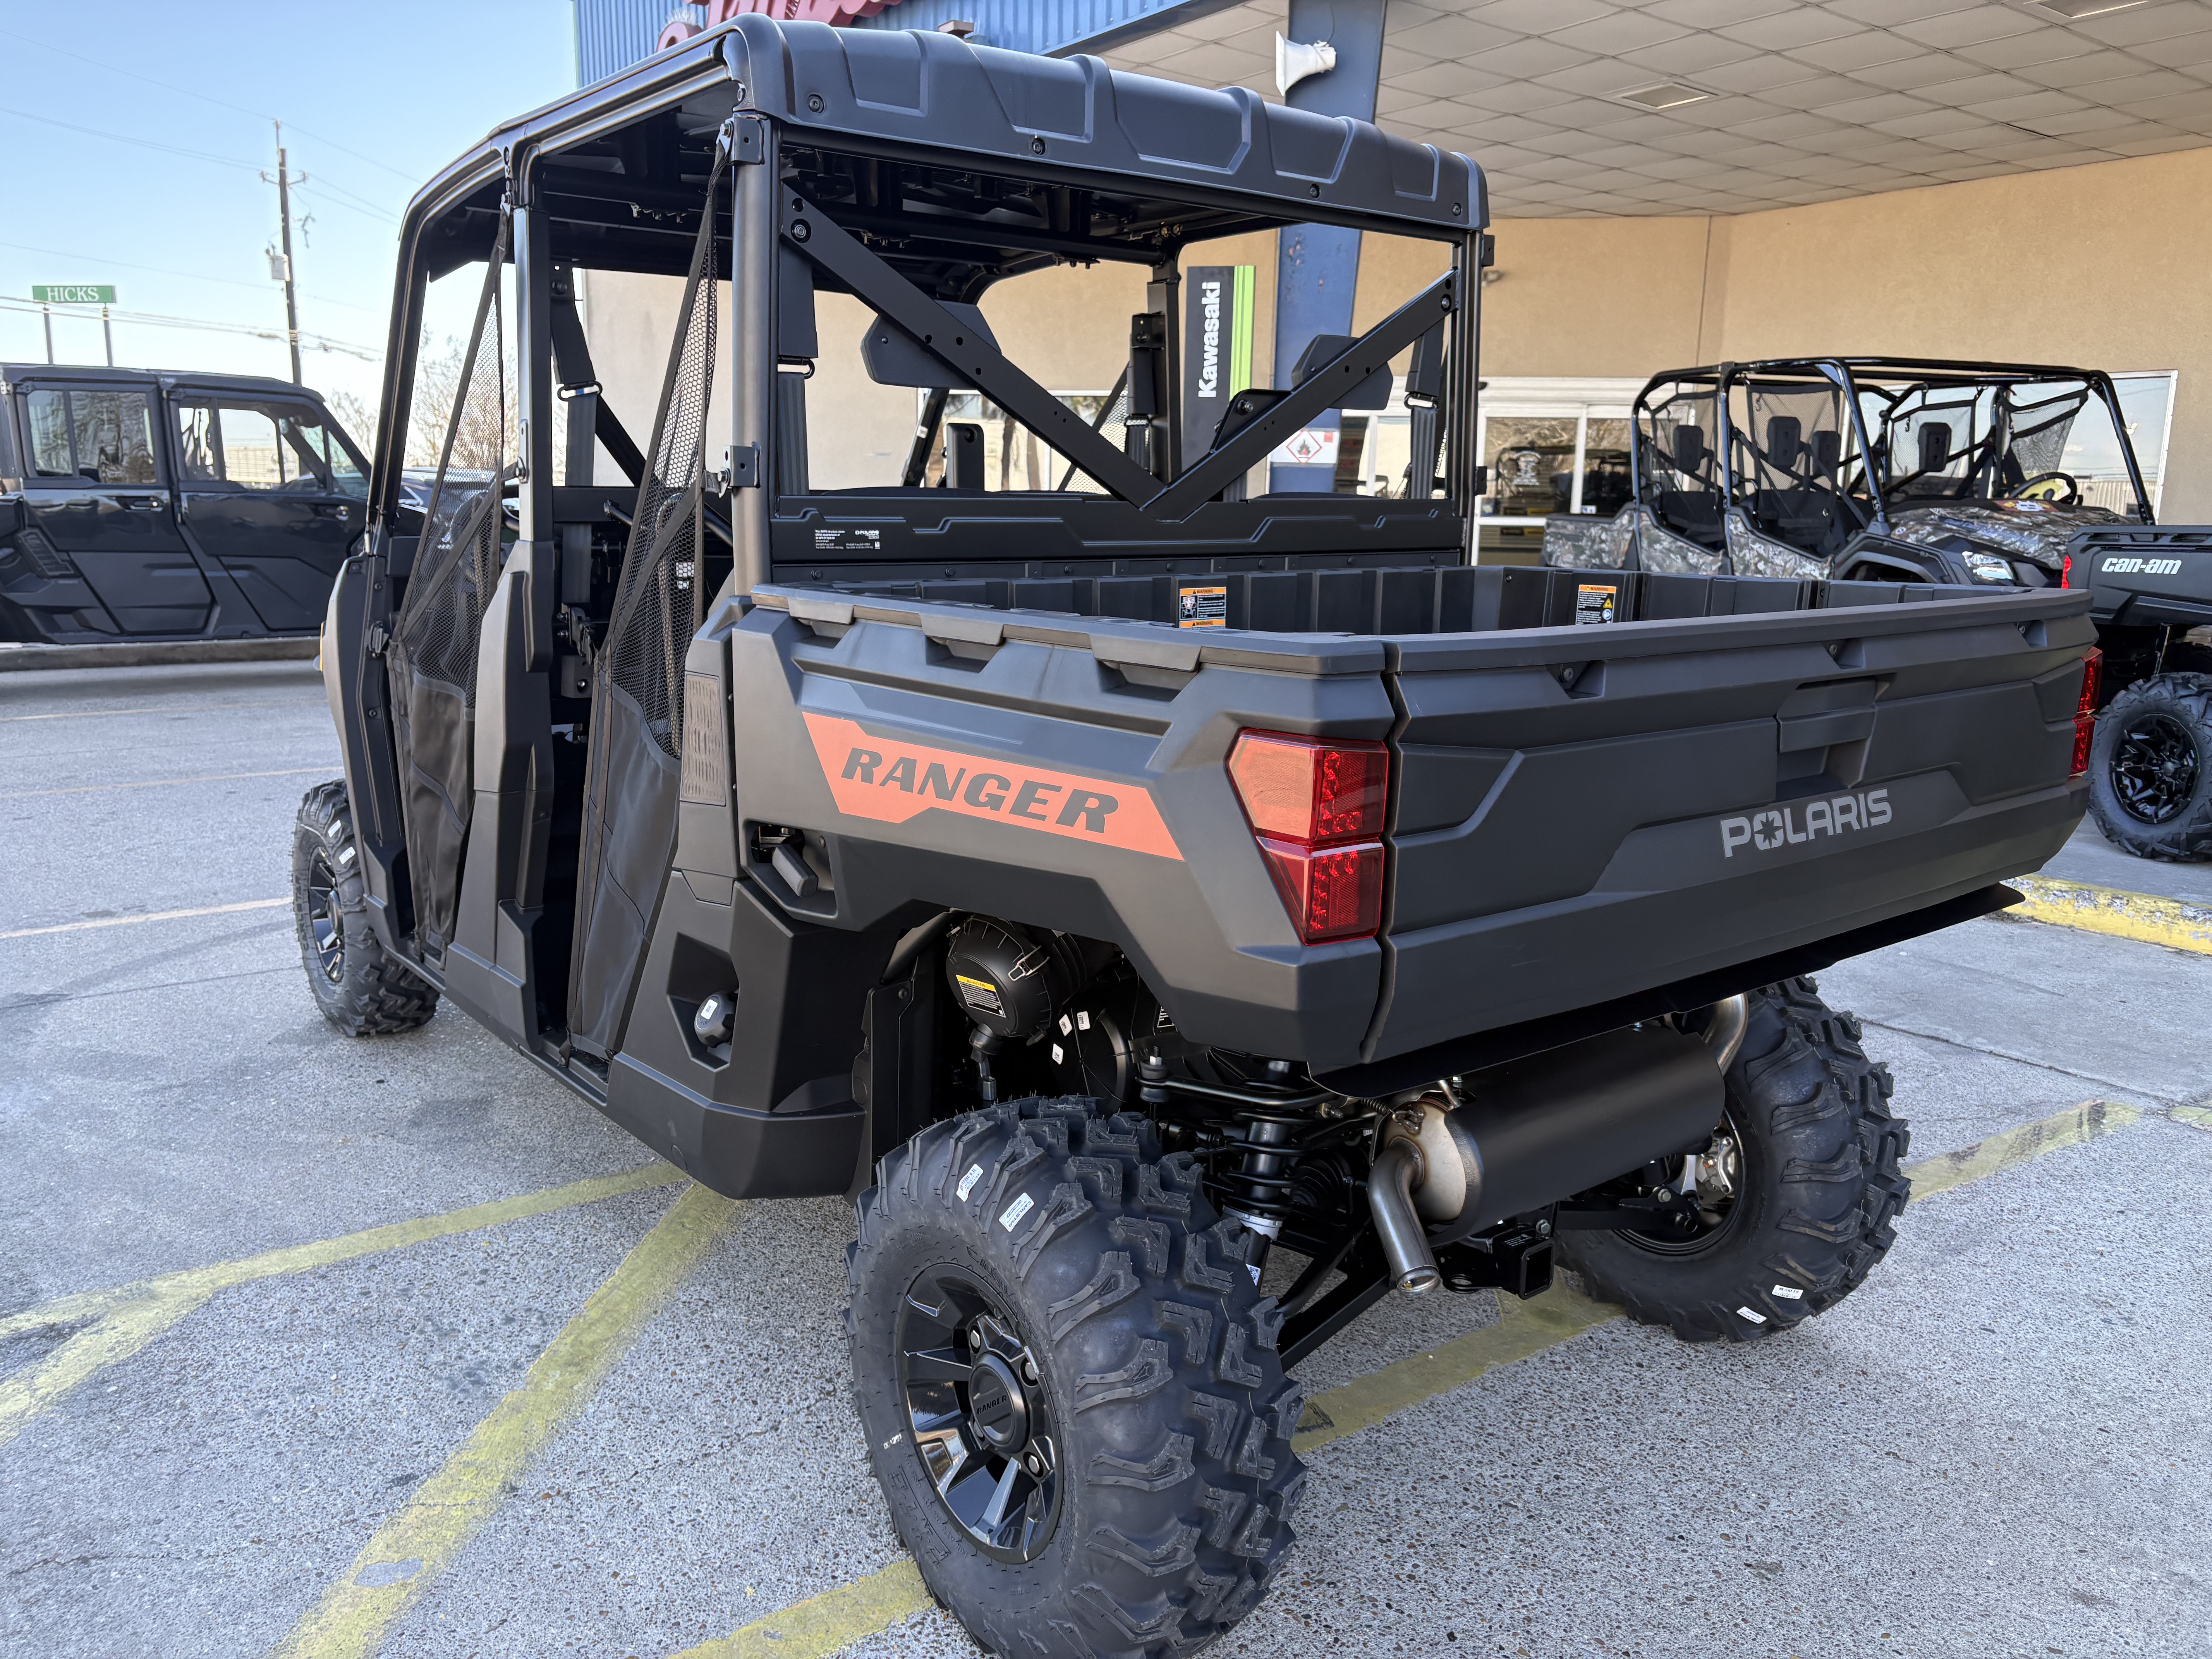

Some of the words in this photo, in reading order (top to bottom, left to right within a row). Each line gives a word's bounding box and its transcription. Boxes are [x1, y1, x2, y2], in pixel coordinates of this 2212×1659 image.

[47, 287, 99, 302] HICKS
[1198, 282, 1220, 397] Kawasaki
[2101, 558, 2182, 574] can-am
[841, 747, 1119, 833] RANGER
[1720, 788, 1892, 859] POLARIS
[977, 1395, 1007, 1415] RANGER
